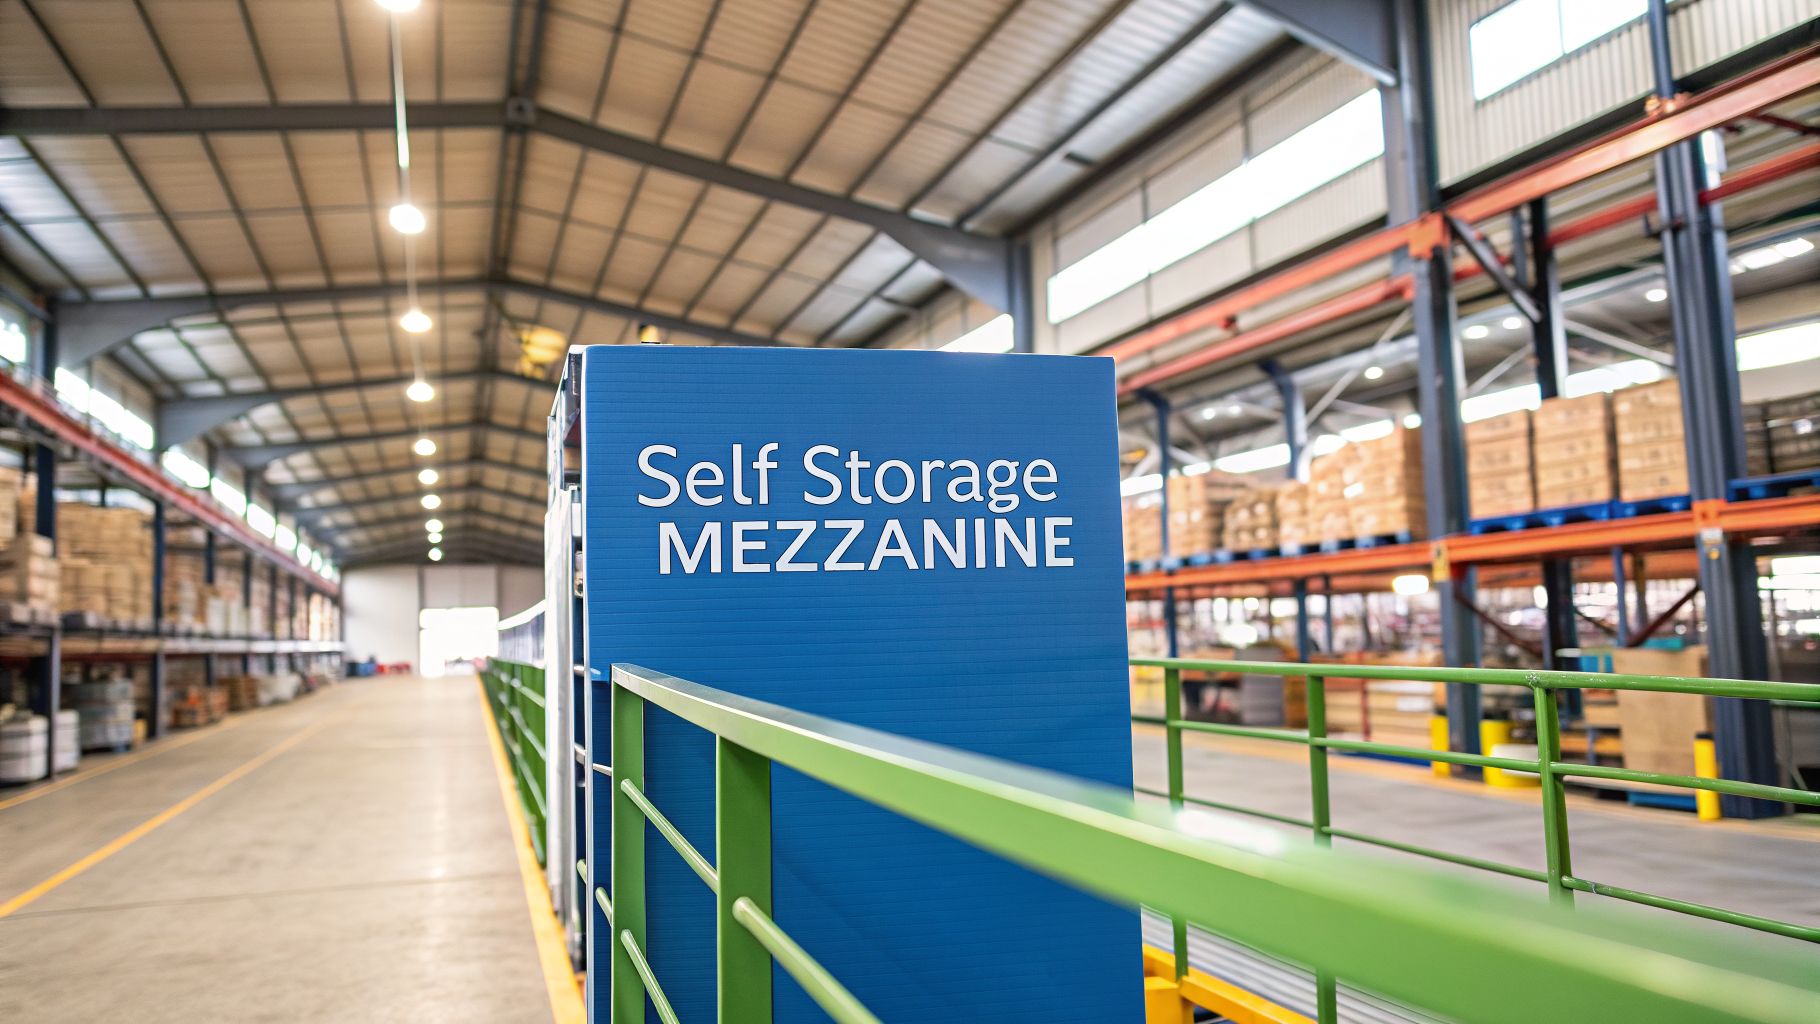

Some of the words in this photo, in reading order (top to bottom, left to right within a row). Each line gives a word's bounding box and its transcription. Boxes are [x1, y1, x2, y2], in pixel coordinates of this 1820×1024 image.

[637, 442, 779, 508] Self
[803, 444, 1059, 514] Storage
[658, 517, 1075, 575] MEZZANINE
